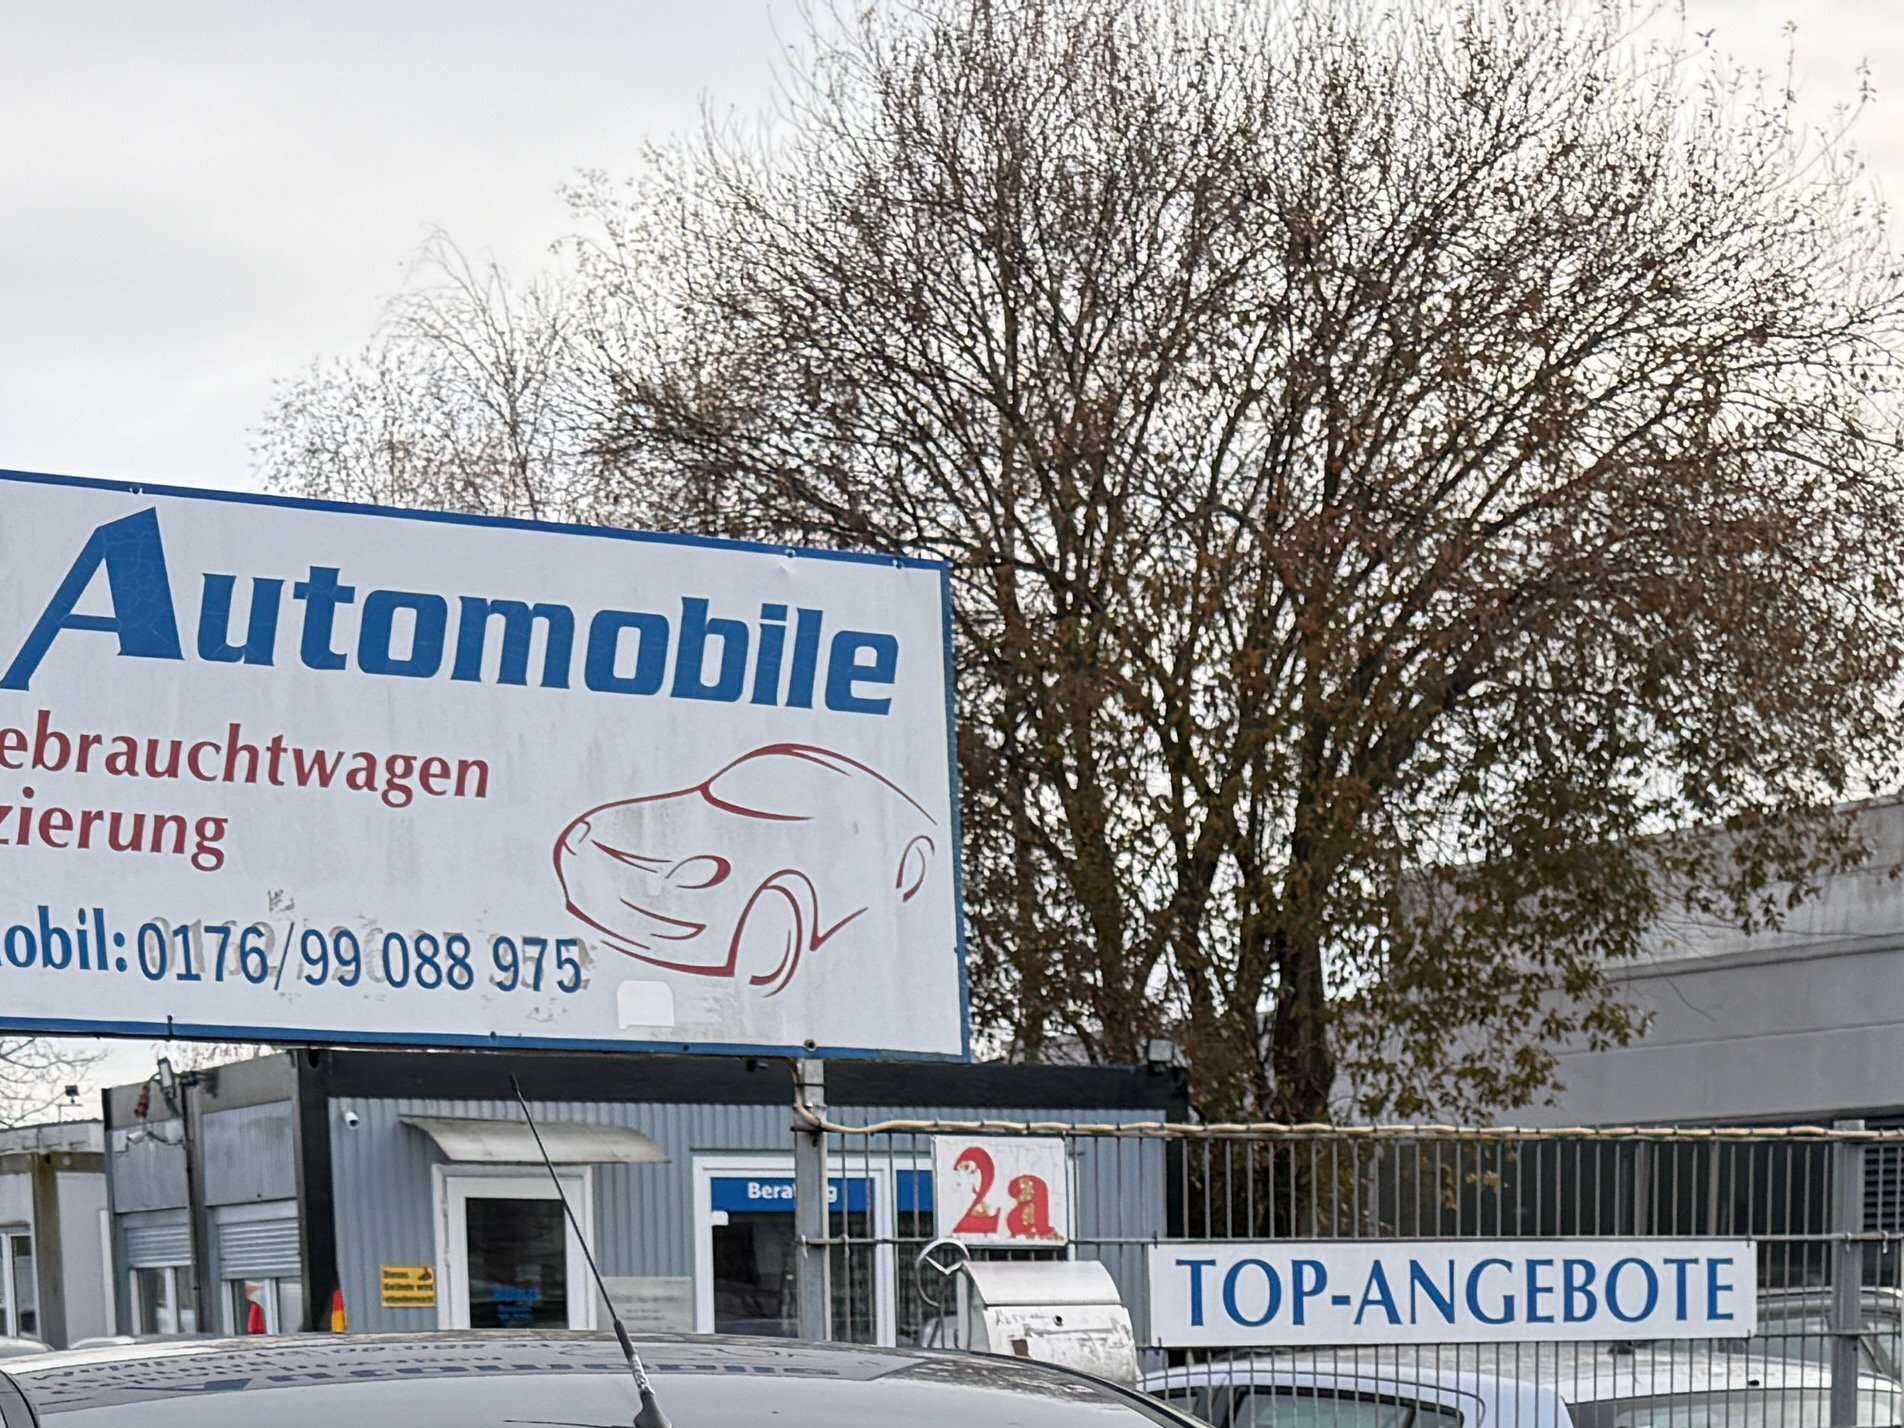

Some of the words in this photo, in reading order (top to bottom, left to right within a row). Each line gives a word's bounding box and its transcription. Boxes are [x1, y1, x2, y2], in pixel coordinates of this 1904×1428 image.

[137, 920, 361, 988] 0176/99
[382, 931, 475, 992] 088
[496, 936, 582, 994] 975
[952, 1146, 1063, 1239] 2a
[1174, 1256, 1735, 1328] TOP-ANGEBOTE
